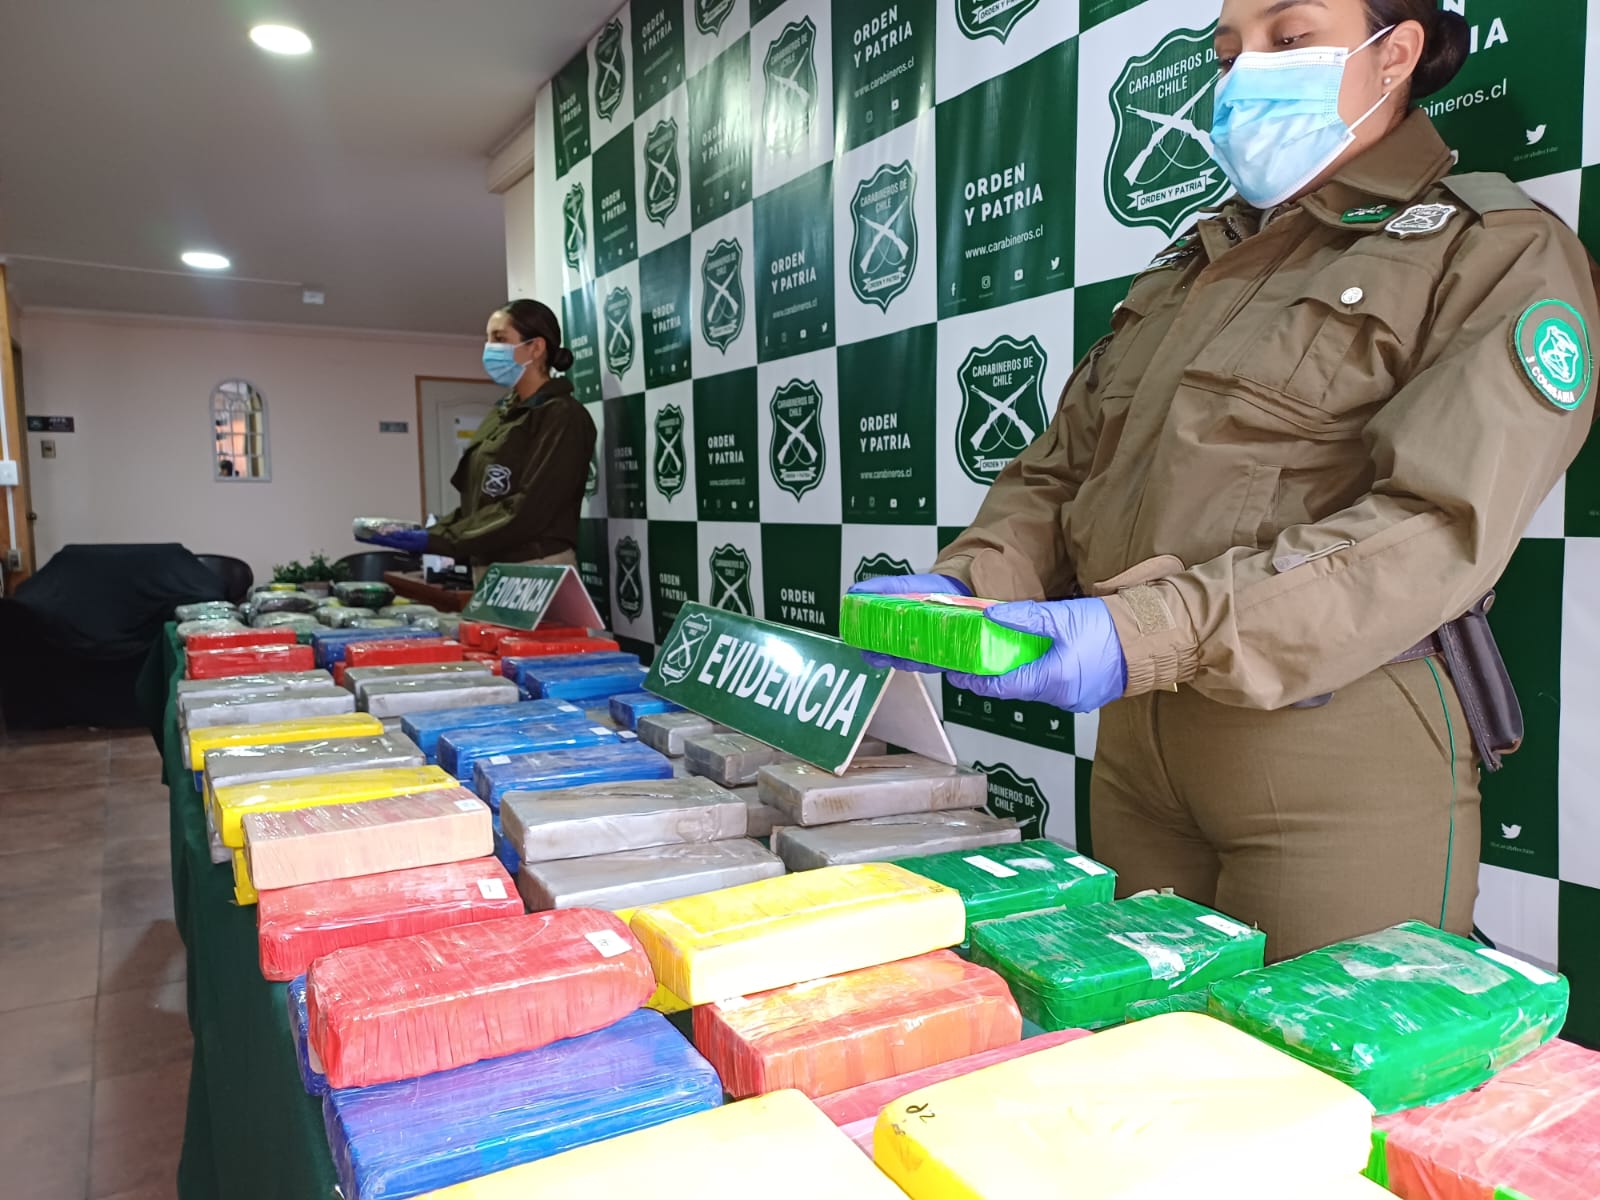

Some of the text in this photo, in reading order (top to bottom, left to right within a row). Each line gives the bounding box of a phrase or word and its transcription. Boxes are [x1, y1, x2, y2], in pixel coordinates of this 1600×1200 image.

[853, 5, 897, 46] ORDEN
[853, 21, 913, 69] Y PATRIA
[1129, 52, 1202, 95] CARABINEROS
[1157, 75, 1188, 99] CHILE
[964, 162, 1025, 201] ORDEN
[1140, 180, 1202, 205] ORDEN Y PATRIA
[964, 184, 1043, 226] Y PATRIA
[965, 224, 1043, 259] www.carabineros.cl
[771, 250, 805, 275] ORDEN
[771, 267, 817, 295] Y PATRIA
[972, 356, 1034, 378] CARABINEROS DE
[993, 373, 1013, 387] CHILE
[860, 413, 897, 432] ORDEN
[707, 434, 735, 448] ORDEN
[860, 433, 911, 452] Y PATRIA
[708, 450, 744, 464] Y PATRIA
[486, 576, 554, 612] EVIDENCIA
[781, 588, 815, 605] ORDEN
[782, 606, 826, 625] Y PATRIA
[697, 633, 868, 737] EVIDENCIA
[994, 796, 1015, 813] CHILE
[1025, 794, 1035, 808] DE
